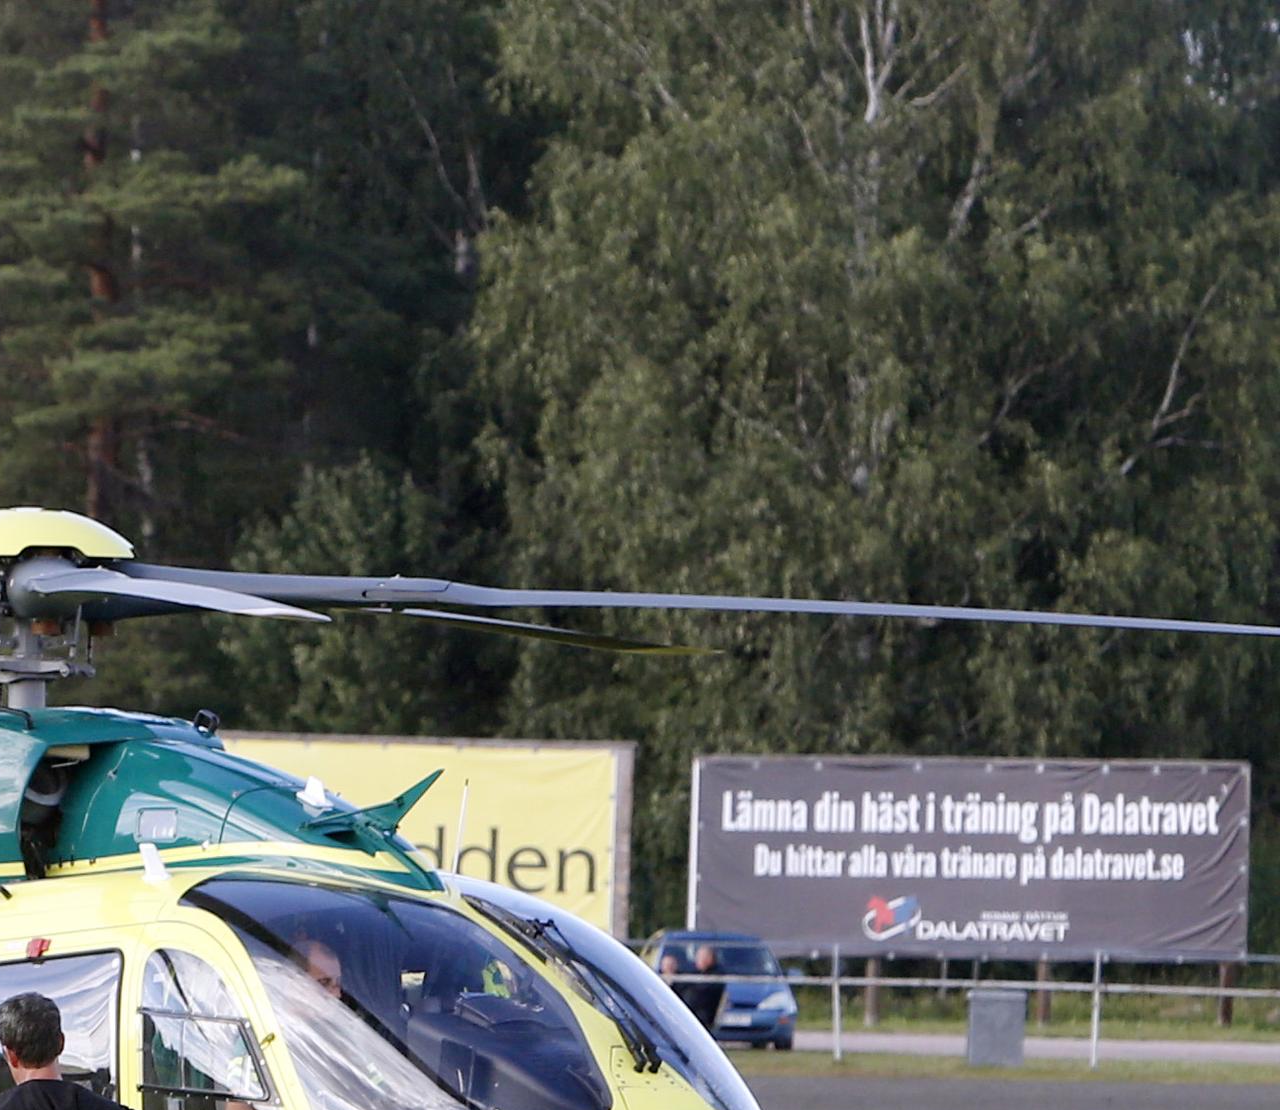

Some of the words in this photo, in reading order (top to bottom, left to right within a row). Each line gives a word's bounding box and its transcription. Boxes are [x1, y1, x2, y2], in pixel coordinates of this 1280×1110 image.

[721, 790, 808, 832] Lämna
[813, 791, 855, 832] din
[861, 791, 920, 834] häst
[925, 791, 935, 833] i
[941, 792, 1038, 843] träning
[1043, 791, 1075, 843] på
[1081, 793, 1219, 835] Dalatravet
[753, 843, 782, 877] Du
[785, 844, 845, 877] hittar
[848, 845, 887, 877] alla
[891, 844, 937, 878] våra
[941, 845, 1017, 879] tränare
[1020, 845, 1045, 886] på
[1050, 846, 1185, 880] dalatravet.se
[915, 920, 1070, 942] DALATRAVET
